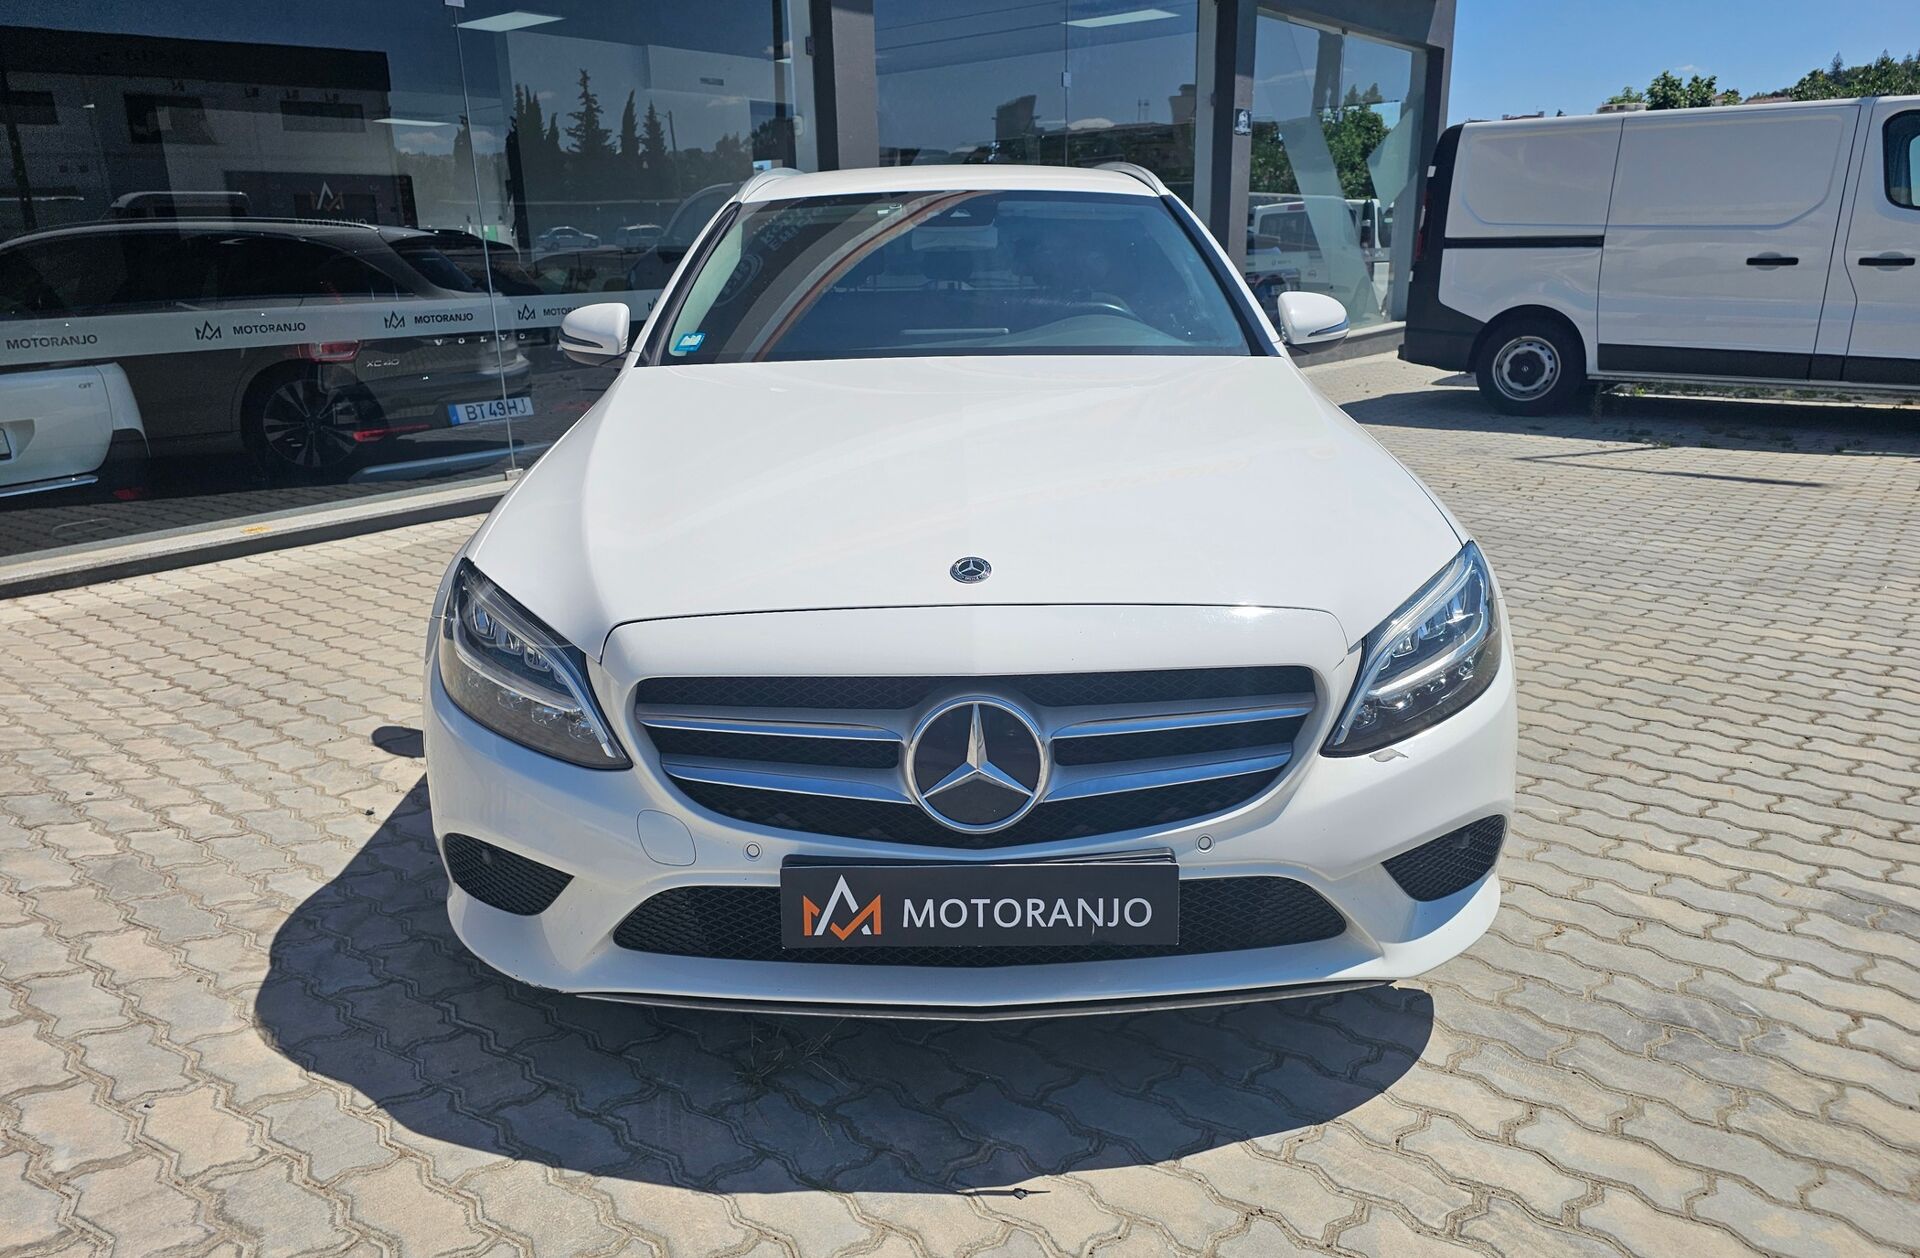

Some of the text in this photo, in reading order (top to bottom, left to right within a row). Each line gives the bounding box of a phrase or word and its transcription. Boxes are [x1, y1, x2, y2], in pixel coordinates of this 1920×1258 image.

[414, 313, 474, 324] MOTORANJO
[232, 322, 306, 336] MOTORANJO
[6, 334, 98, 350] MOTORANJO
[434, 333, 526, 346] VOLVO
[902, 897, 1153, 929] MOTORANJO
